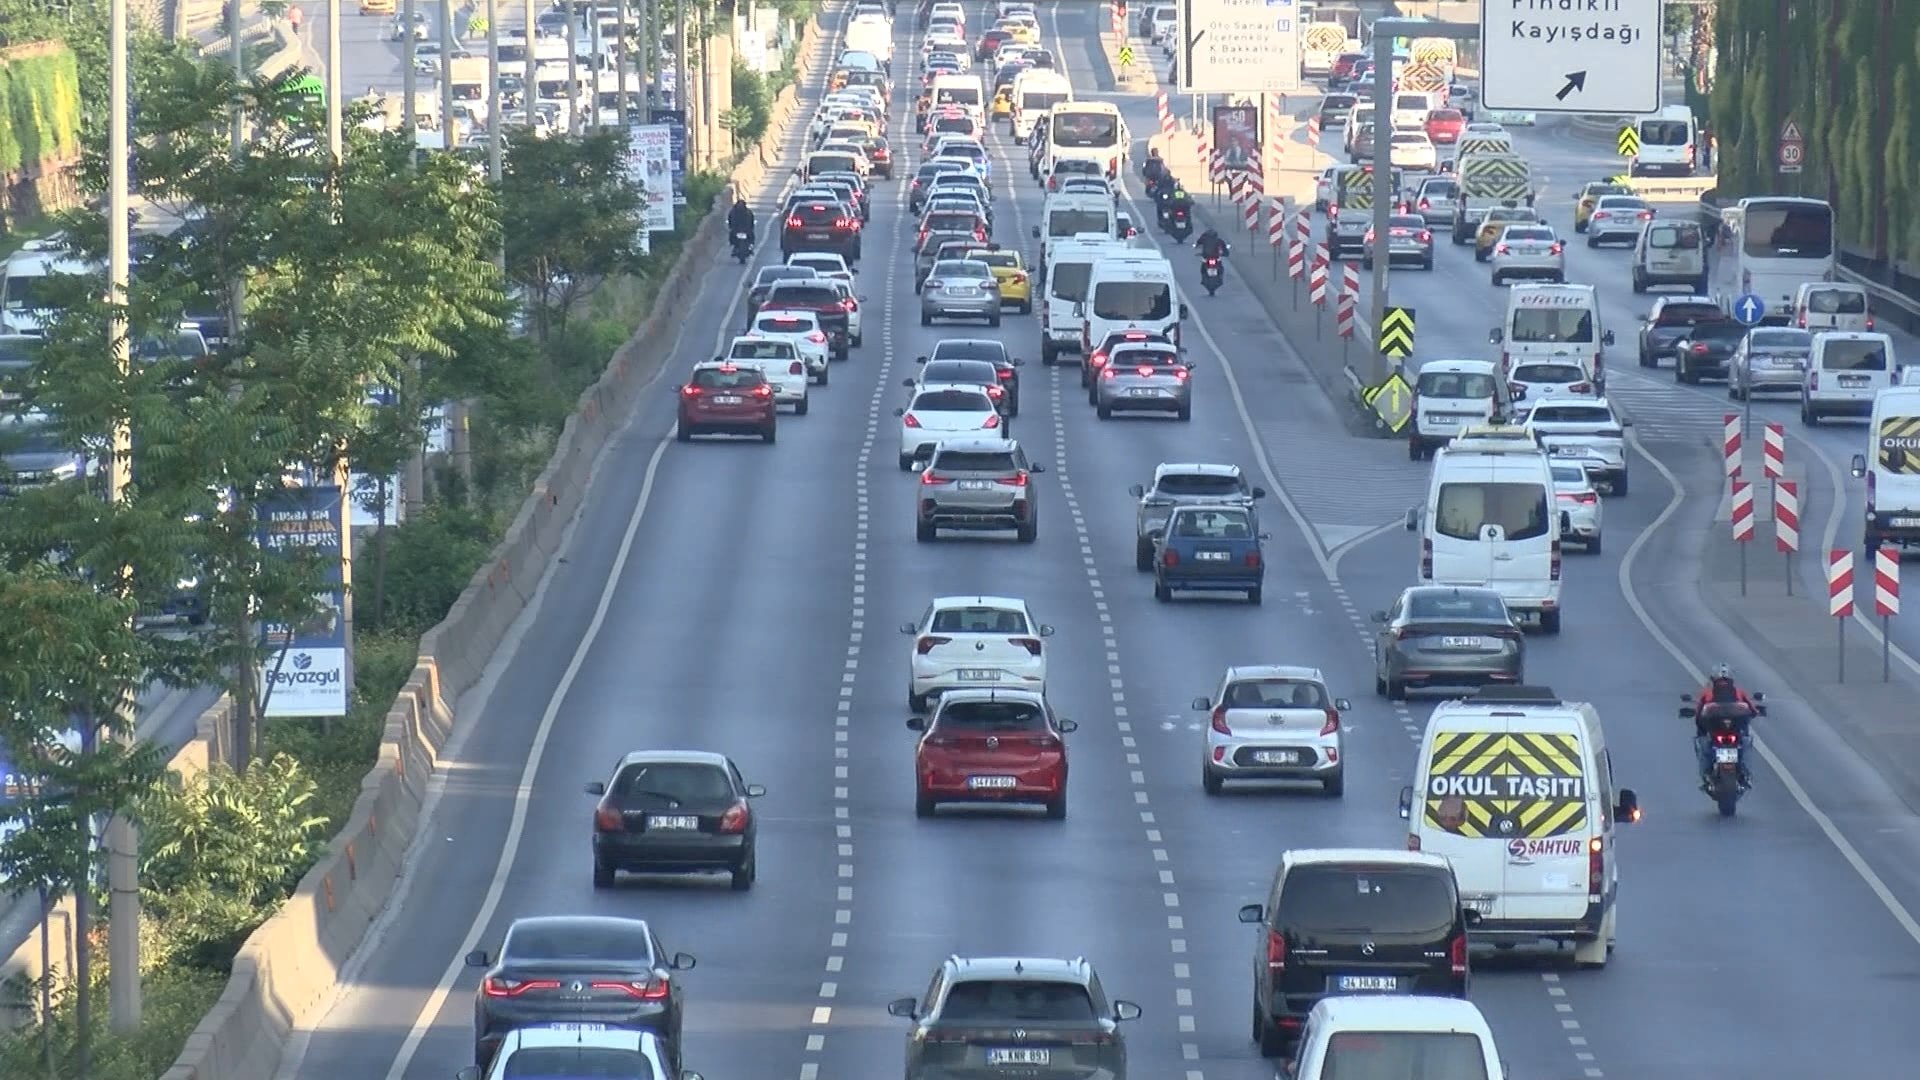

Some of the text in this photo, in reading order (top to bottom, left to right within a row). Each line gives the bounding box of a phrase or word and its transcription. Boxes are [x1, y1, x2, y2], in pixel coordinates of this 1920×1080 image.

[1512, 20, 1640, 44] Kayışdağı
[1785, 148, 1799, 160] 30
[1431, 776, 1581, 801] OKUL TAŞITI
[1528, 839, 1581, 855] SAHTUR
